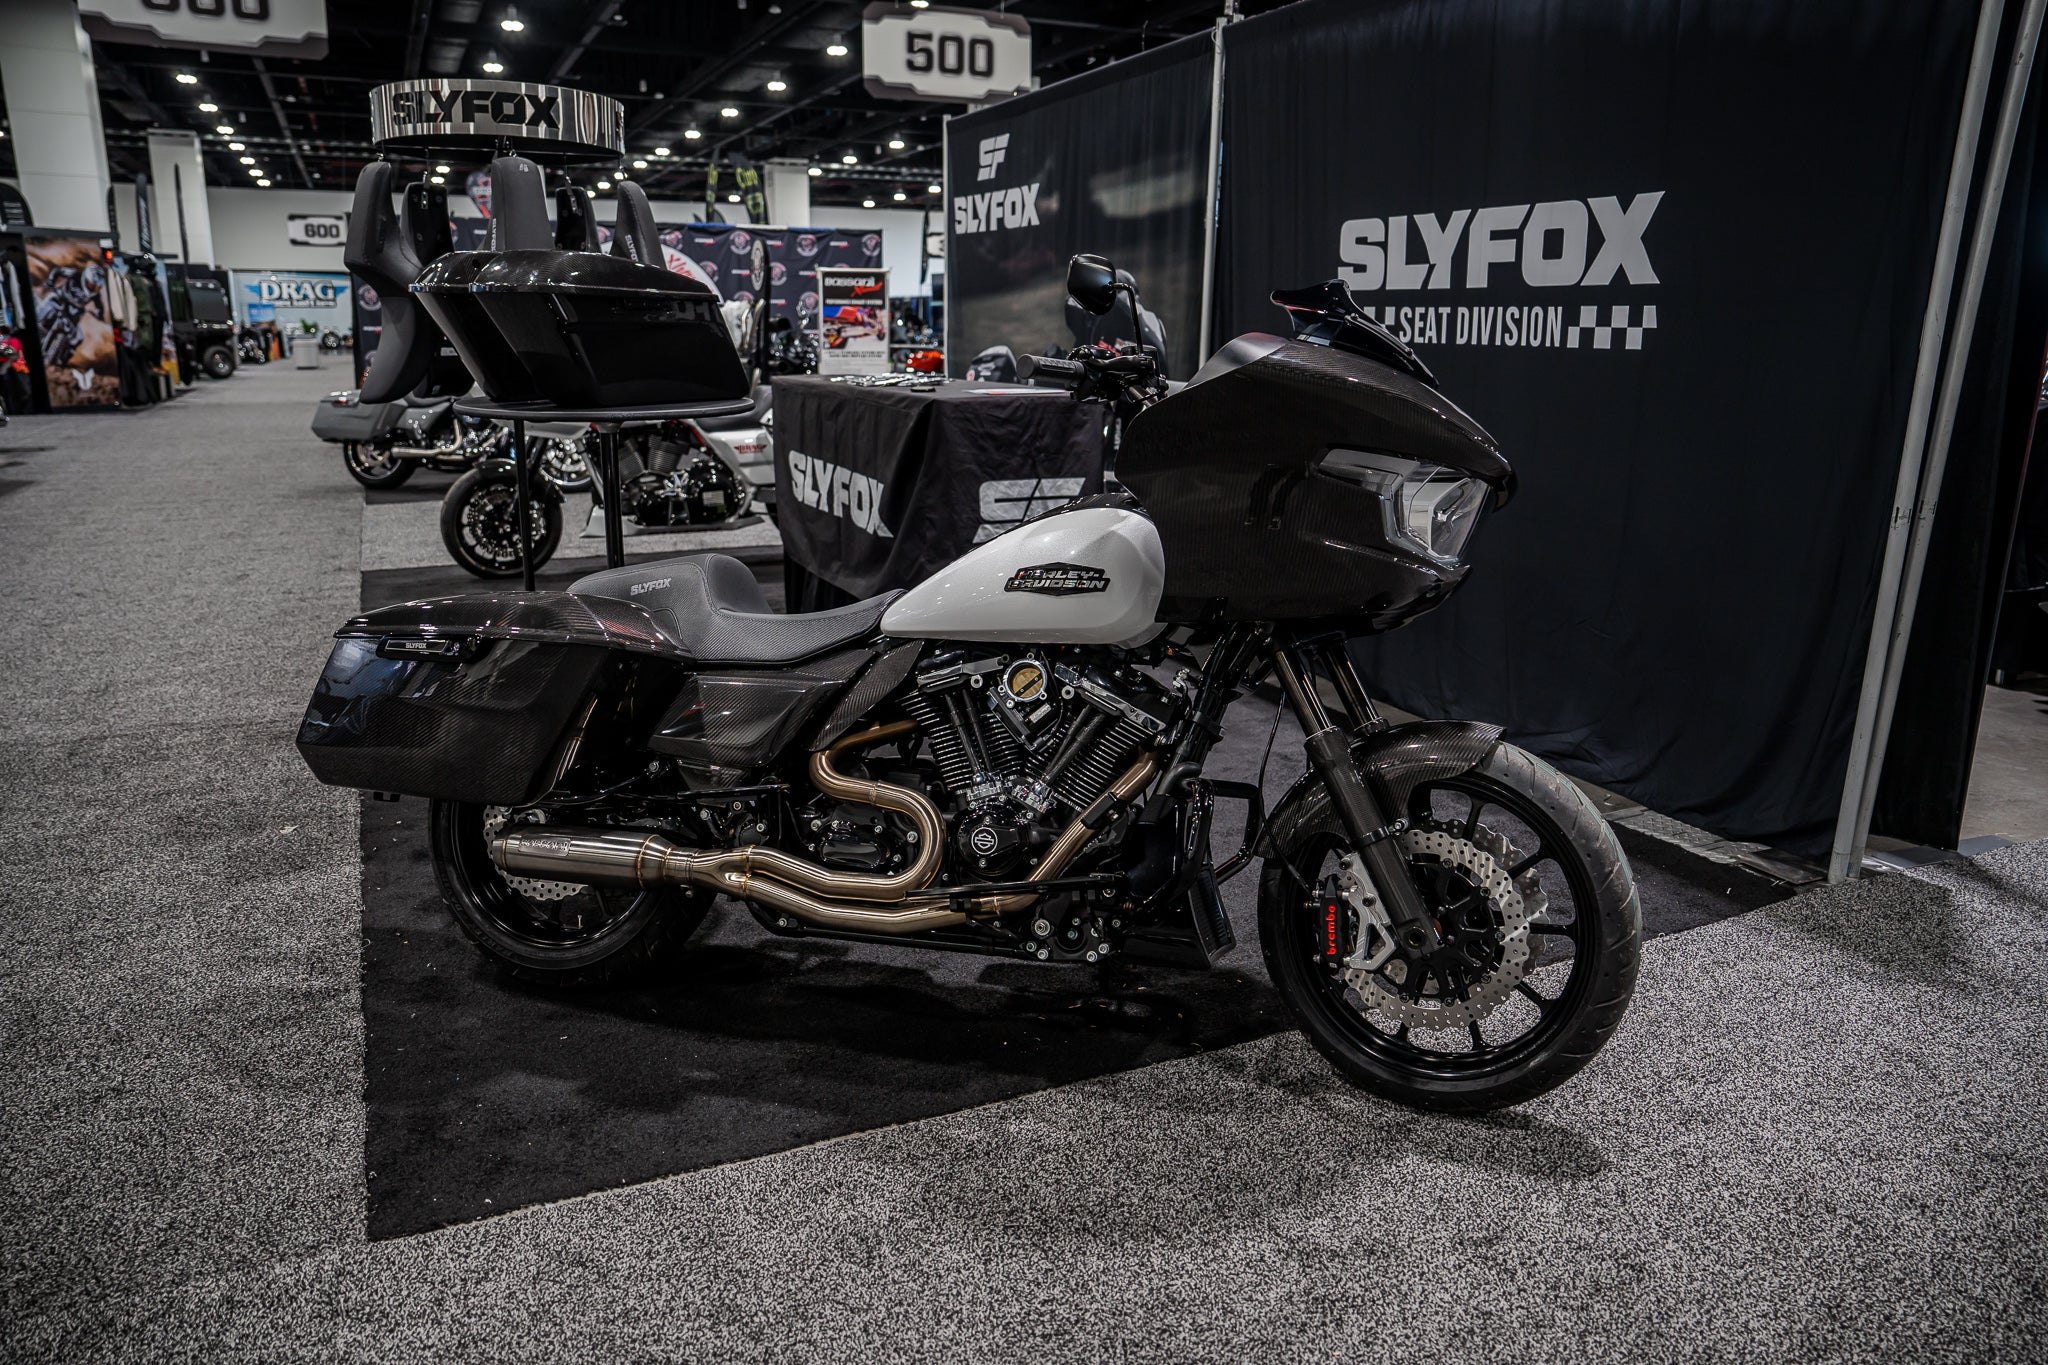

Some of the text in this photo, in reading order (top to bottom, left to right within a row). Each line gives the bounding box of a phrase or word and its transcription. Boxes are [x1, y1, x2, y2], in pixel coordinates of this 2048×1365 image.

[906, 31, 994, 77] 500
[393, 90, 561, 130] SLYFOX
[954, 182, 1040, 234] SLYFOX
[304, 223, 340, 238] 600
[1338, 190, 1666, 291] SLYFOX
[259, 280, 336, 301] DRAG
[1399, 305, 1563, 348] SEAT DIVISION
[789, 450, 894, 539] SLYFOX
[630, 577, 672, 596] SLYFOX
[1326, 904, 1337, 955] brembo
